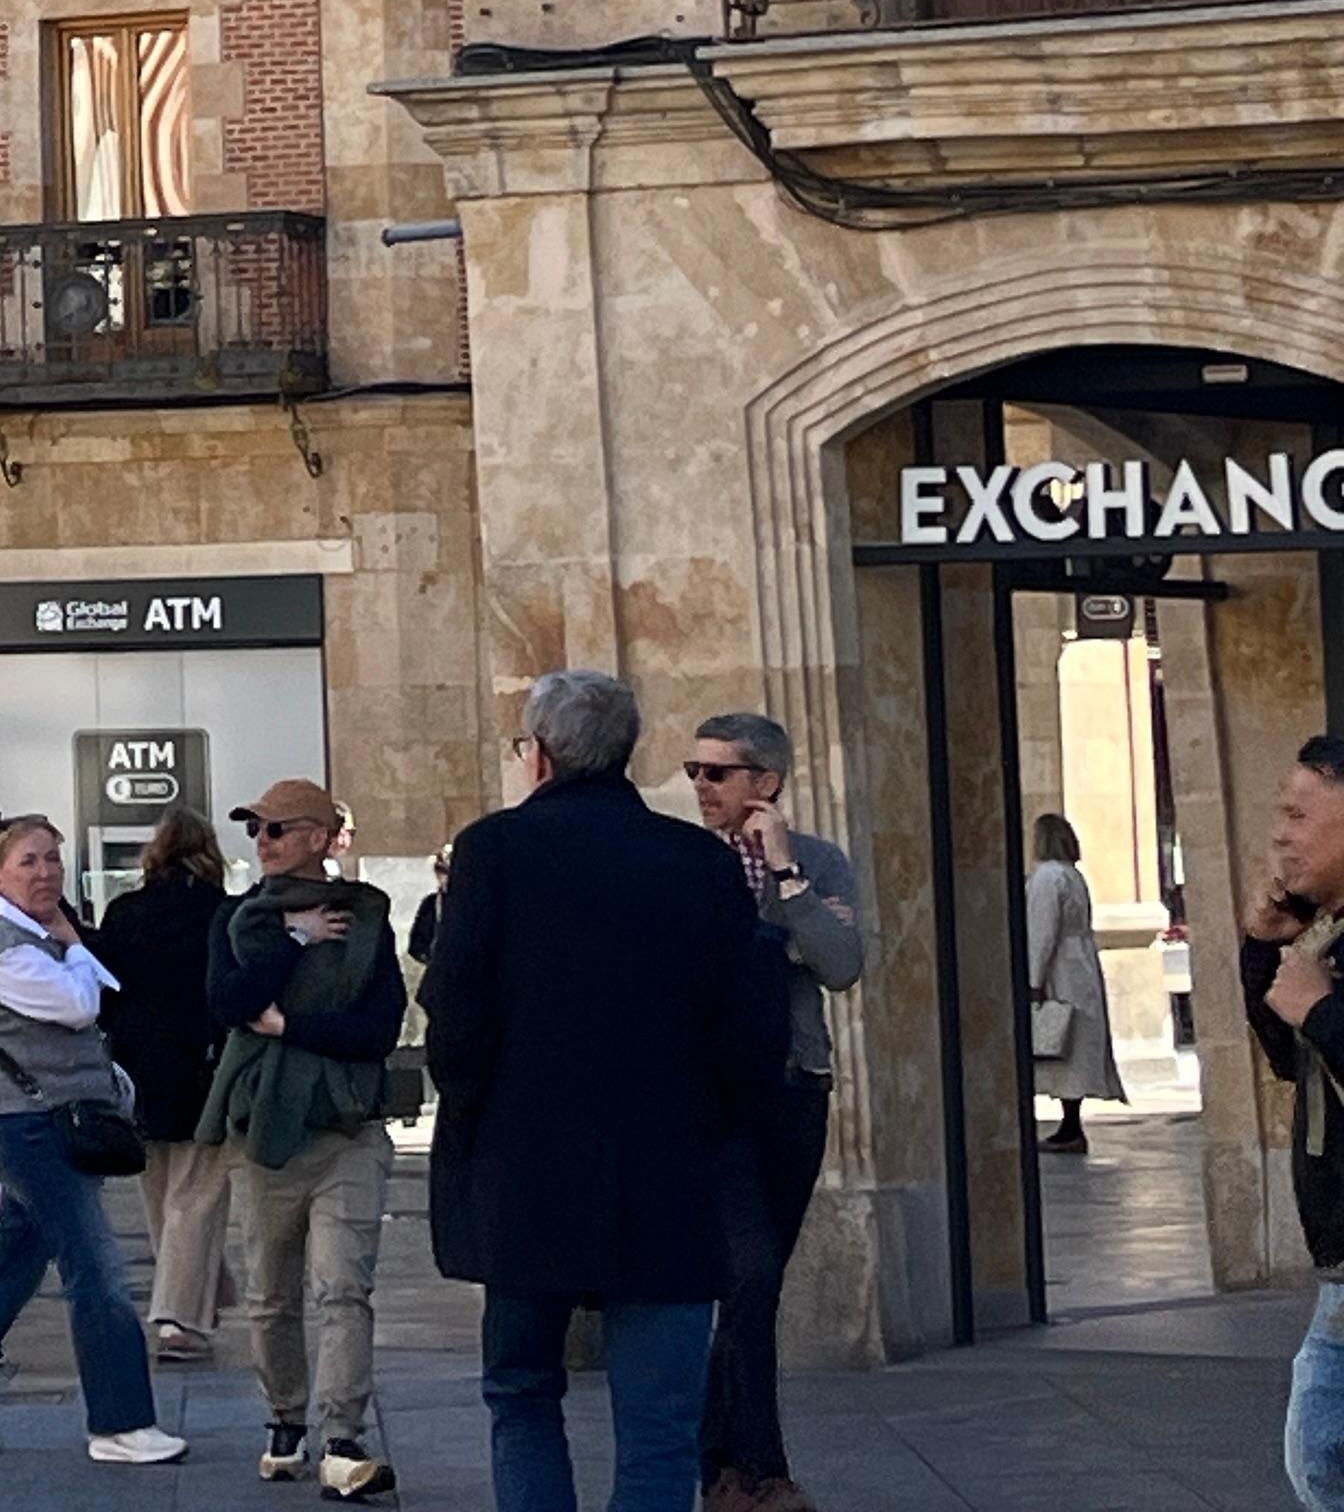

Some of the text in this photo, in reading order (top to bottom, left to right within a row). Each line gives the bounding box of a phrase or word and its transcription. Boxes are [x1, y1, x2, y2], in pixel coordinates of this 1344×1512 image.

[66, 600, 128, 617] Global
[144, 597, 221, 631] ATM
[108, 740, 176, 769] ATM
